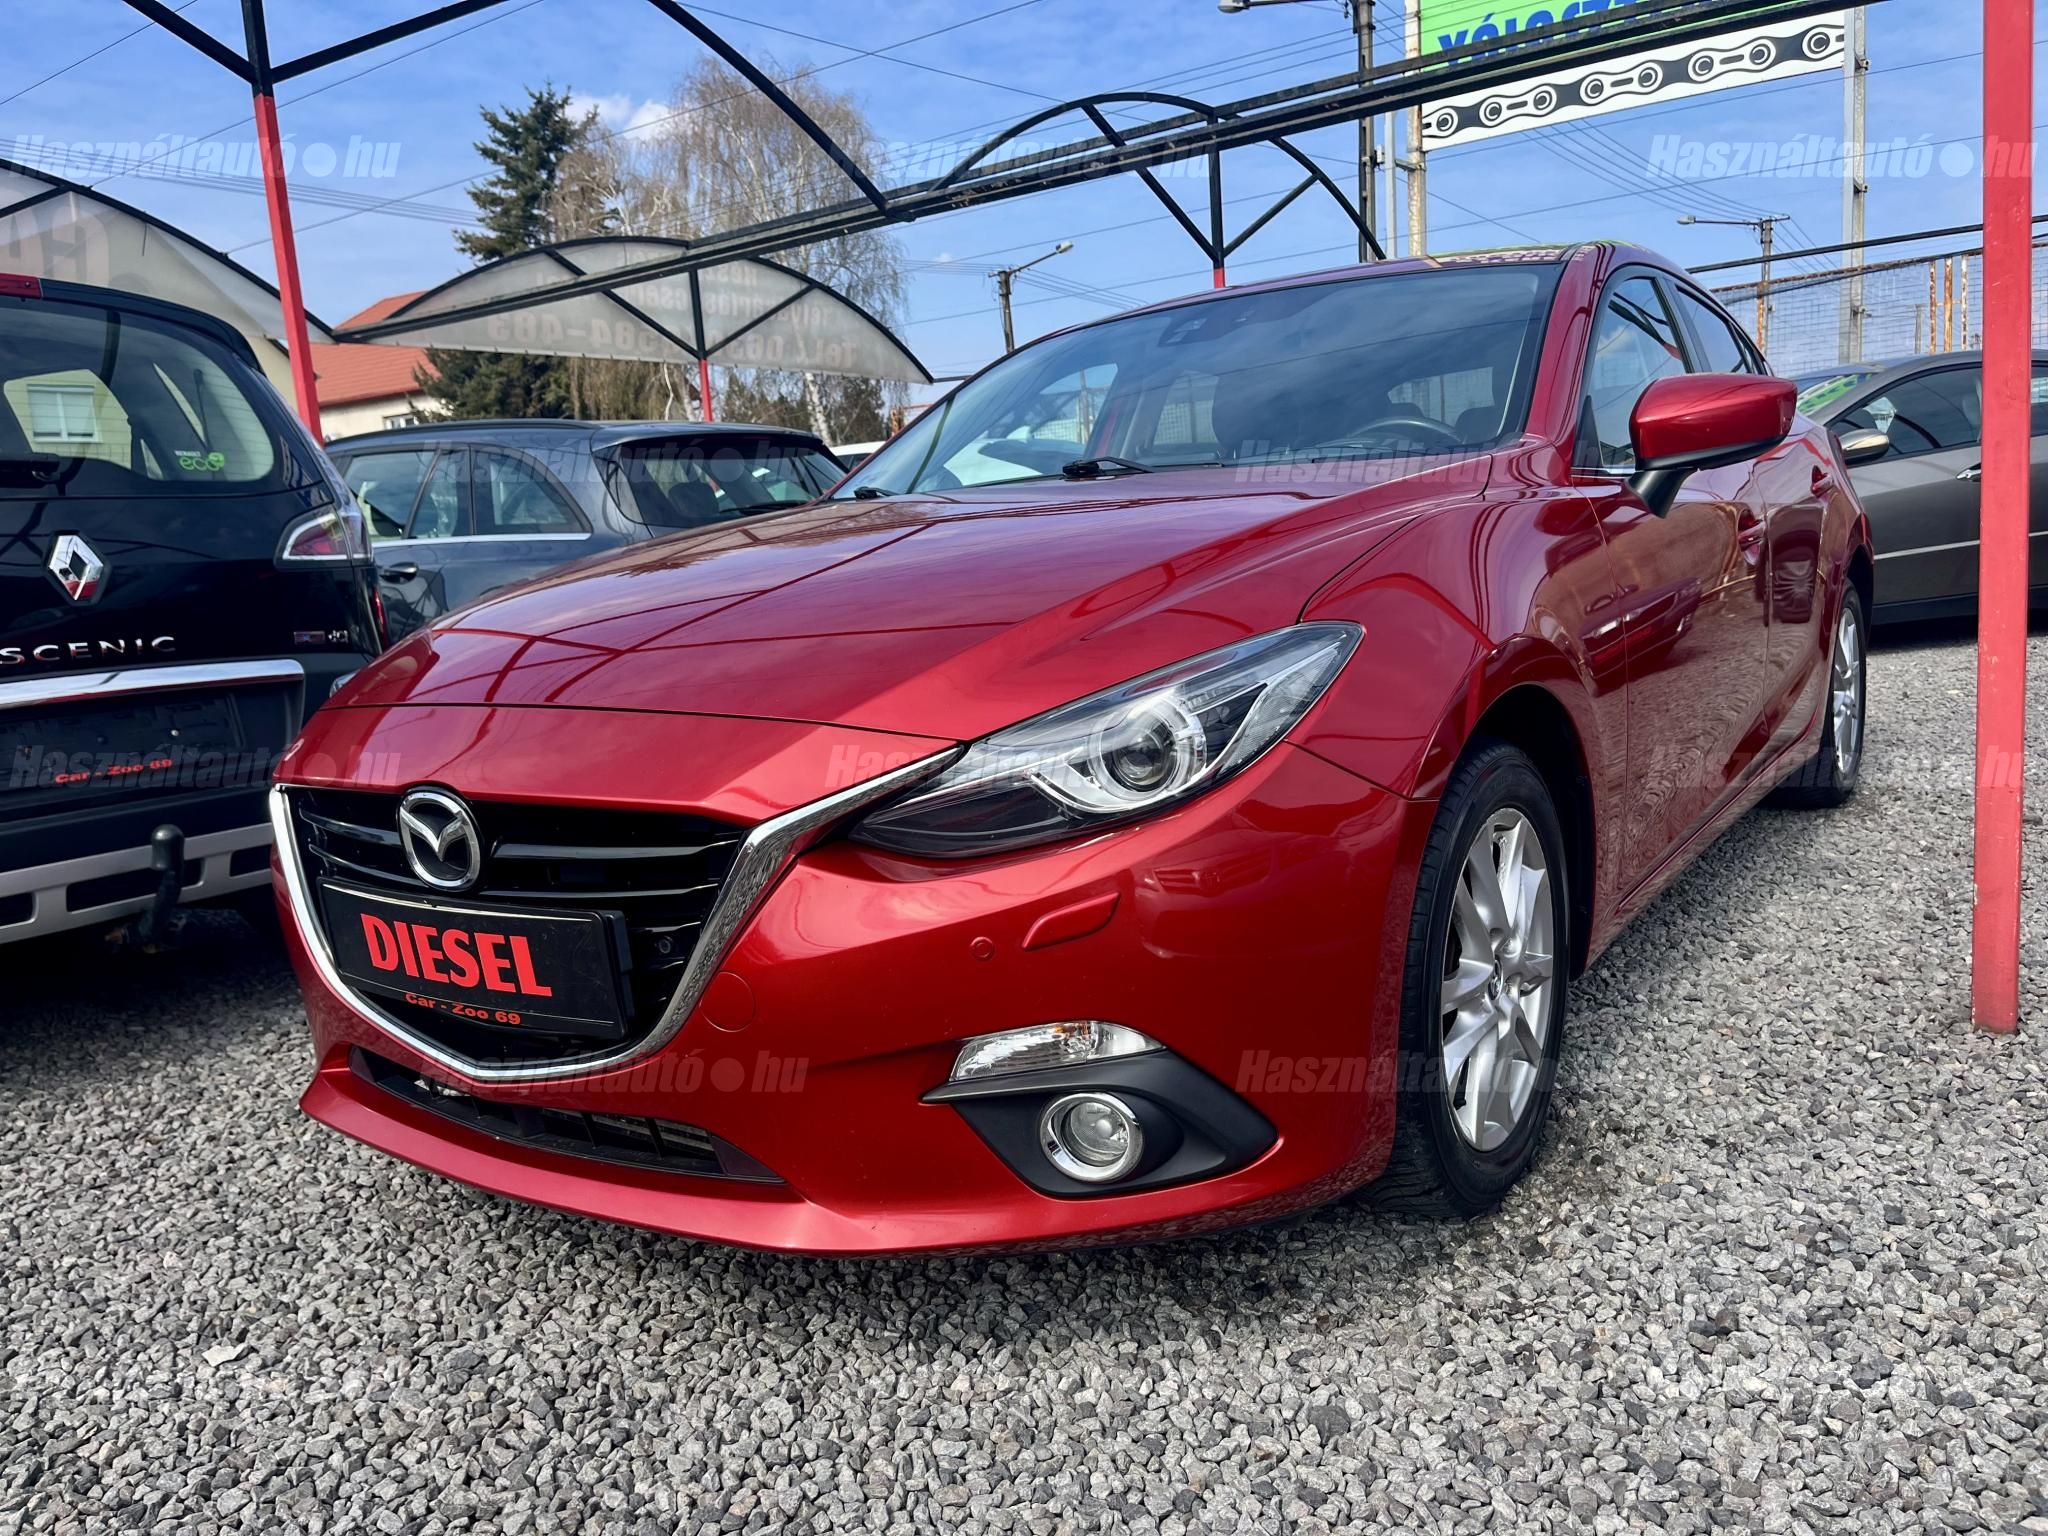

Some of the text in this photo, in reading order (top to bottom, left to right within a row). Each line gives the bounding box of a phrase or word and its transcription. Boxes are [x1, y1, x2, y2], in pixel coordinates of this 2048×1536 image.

[0, 635, 177, 665] SCENIC
[107, 763, 145, 777] Zoo
[360, 913, 553, 997] DIESEL
[405, 991, 435, 1010] Car
[452, 1003, 489, 1020] Zoo
[495, 1011, 521, 1025] 69
